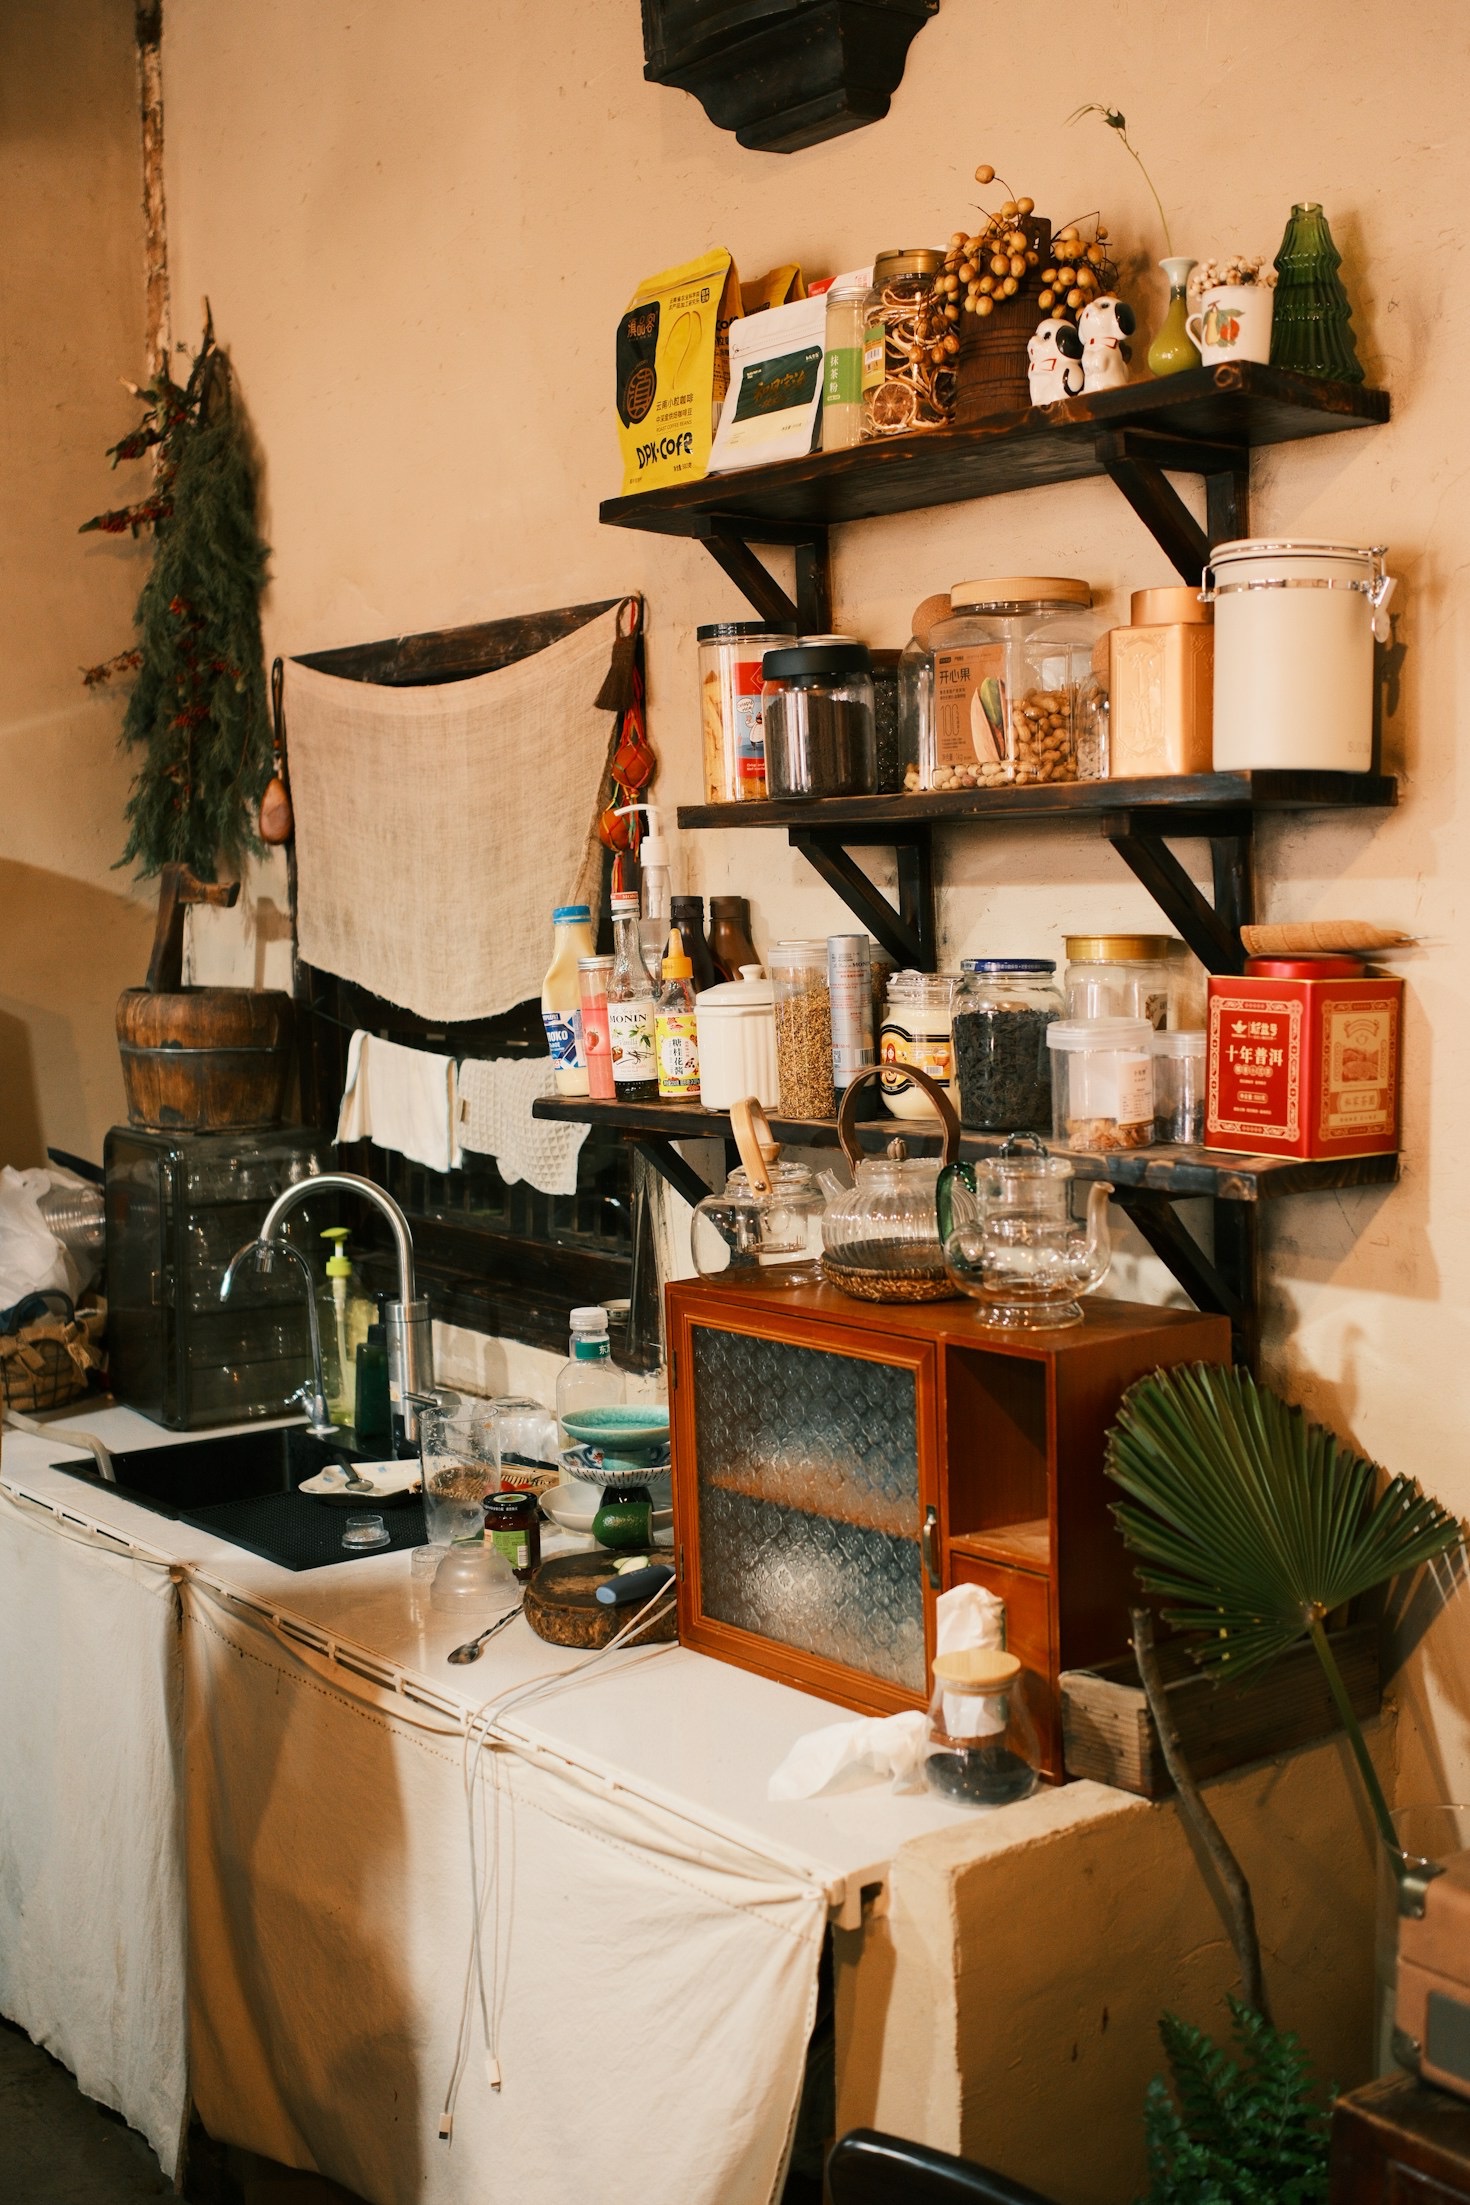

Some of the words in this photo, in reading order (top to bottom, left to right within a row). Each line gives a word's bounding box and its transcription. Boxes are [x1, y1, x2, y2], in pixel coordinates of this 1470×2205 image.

[829, 354, 839, 394] 抹茶粉
[656, 393, 694, 411] 云南小粒咖啡
[939, 667, 971, 684] 开心果
[610, 1013, 647, 1023] MONIN
[1225, 1044, 1284, 1067] 十年普洱
